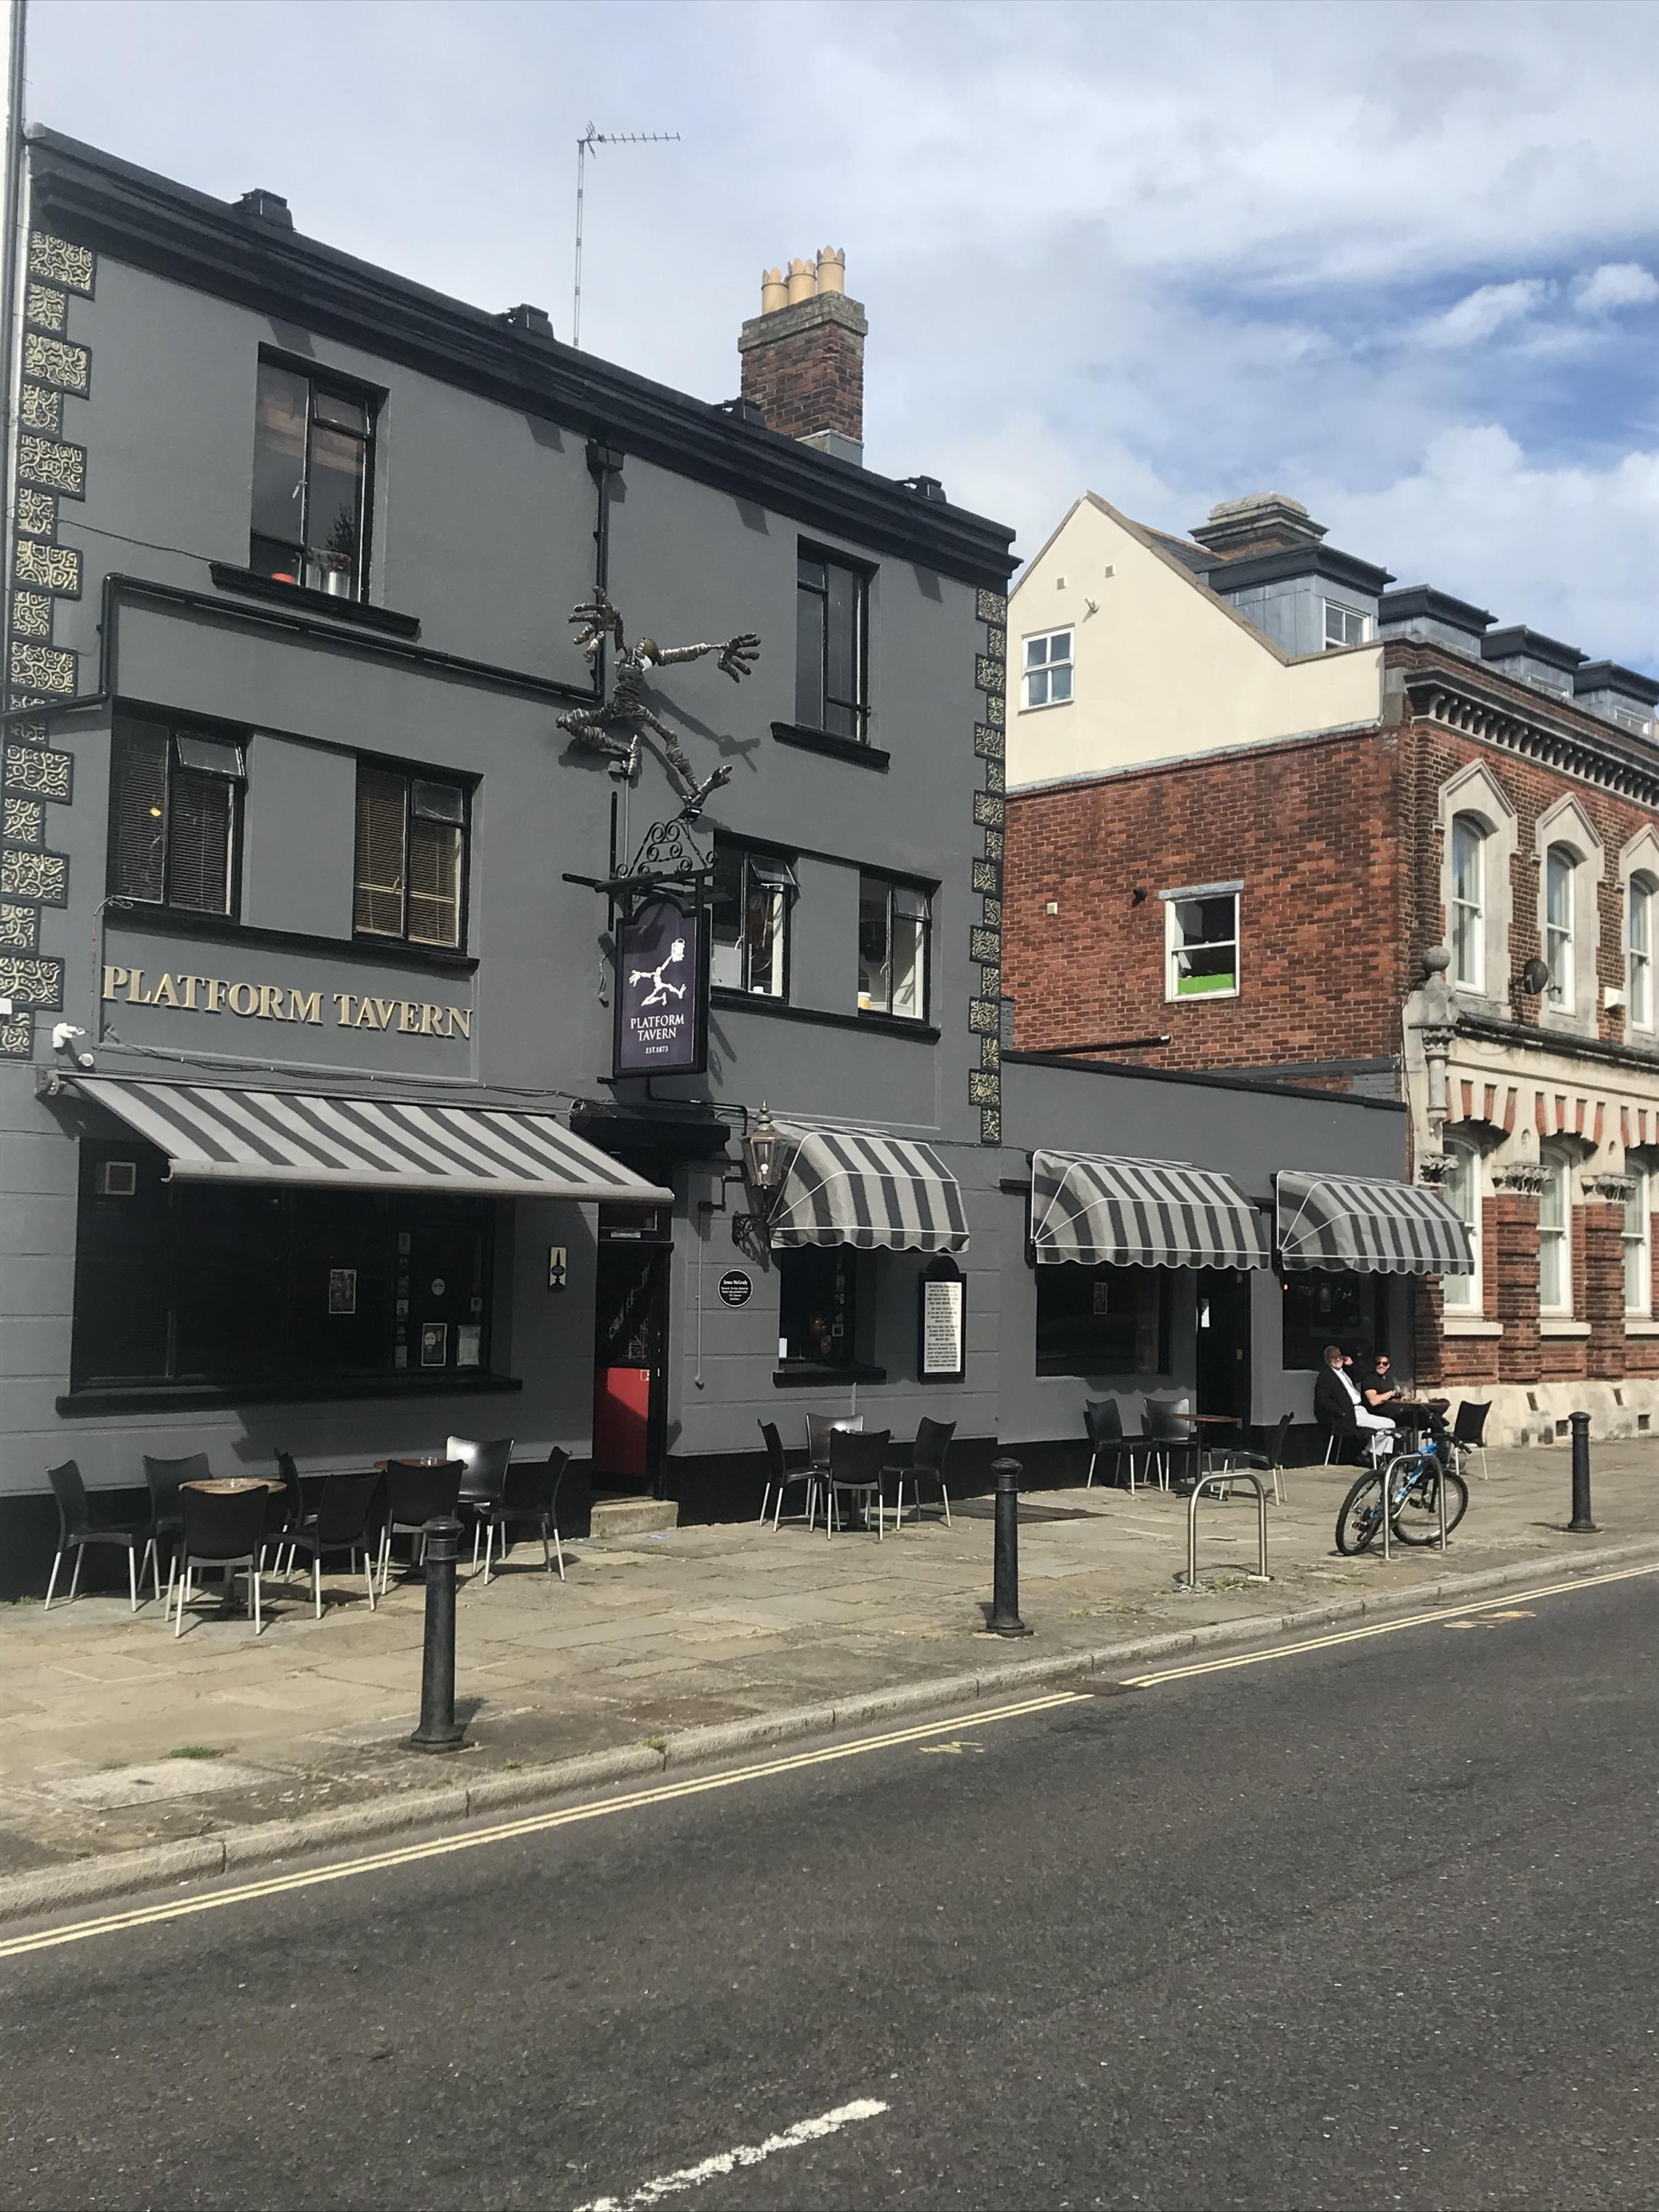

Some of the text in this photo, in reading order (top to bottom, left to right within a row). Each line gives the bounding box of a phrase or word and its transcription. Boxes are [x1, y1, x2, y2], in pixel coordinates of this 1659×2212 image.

[102, 965, 473, 1039] PLATFORM TAVERN
[630, 1013, 684, 1029] PLATFORM
[637, 1027, 677, 1041] TAVERN
